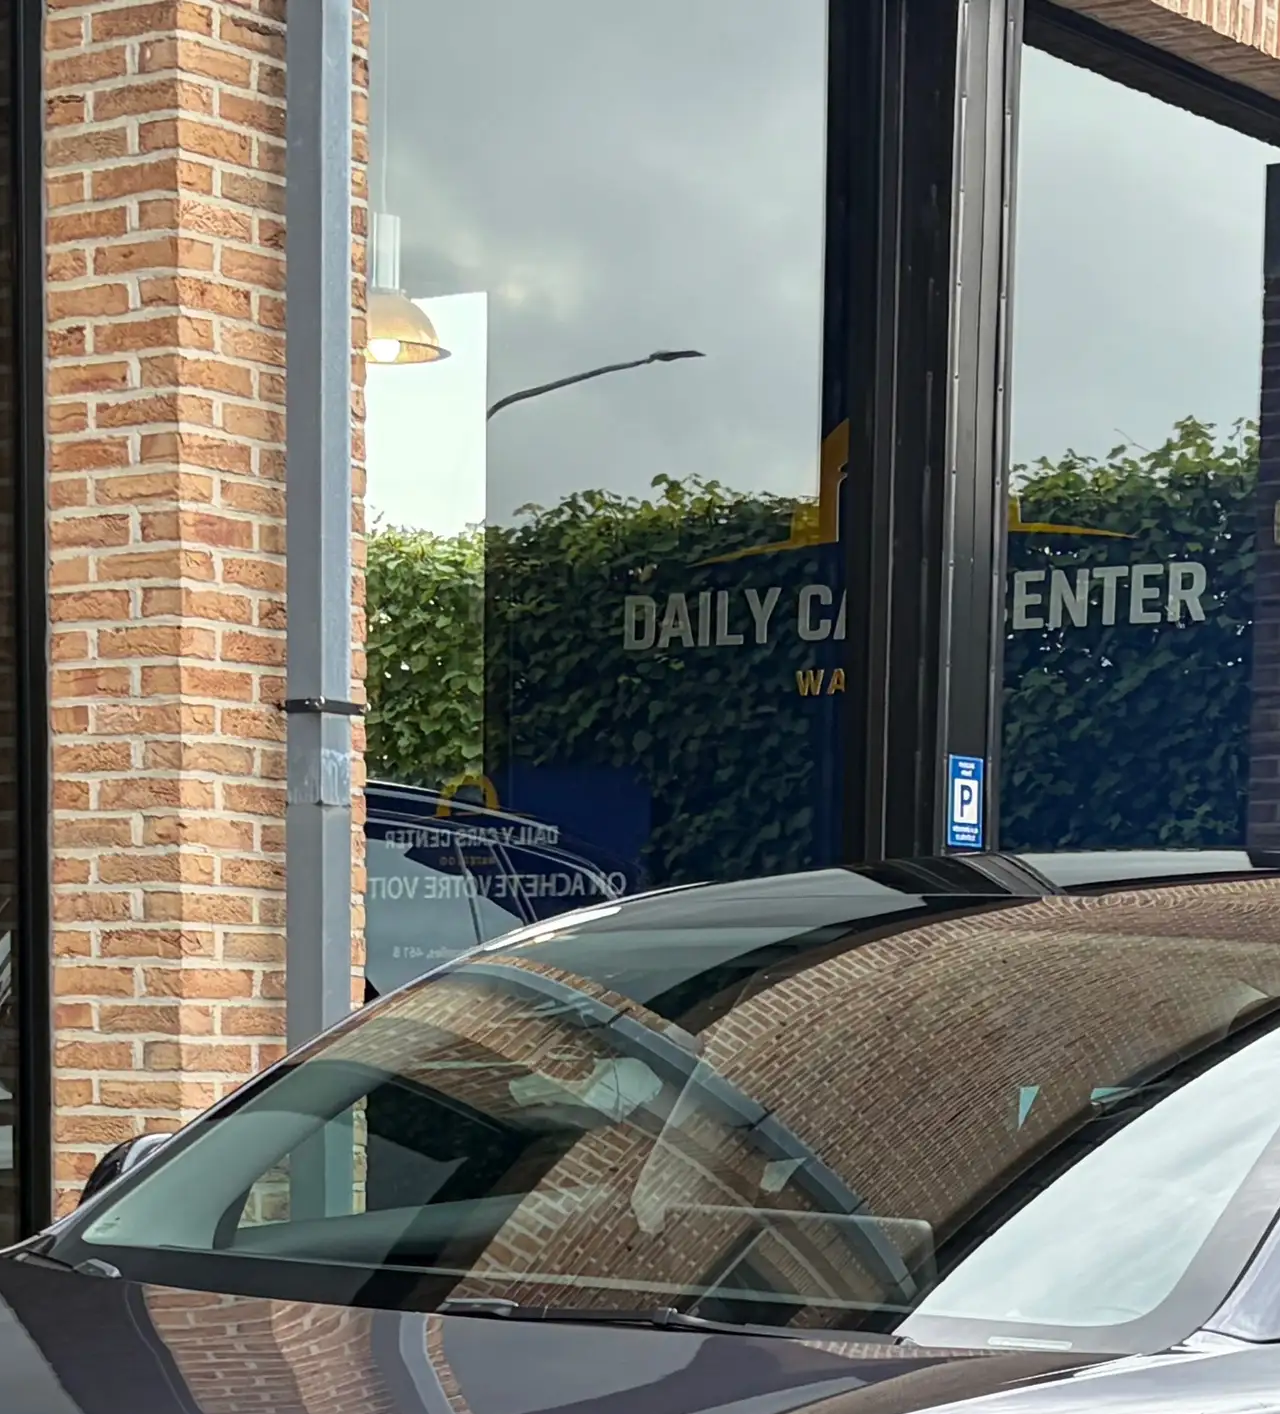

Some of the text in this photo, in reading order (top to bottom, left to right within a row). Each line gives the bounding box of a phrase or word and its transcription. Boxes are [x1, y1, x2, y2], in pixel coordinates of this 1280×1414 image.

[623, 587, 782, 650] DAILY
[1004, 561, 1207, 631] ENTER
[960, 784, 973, 818] P
